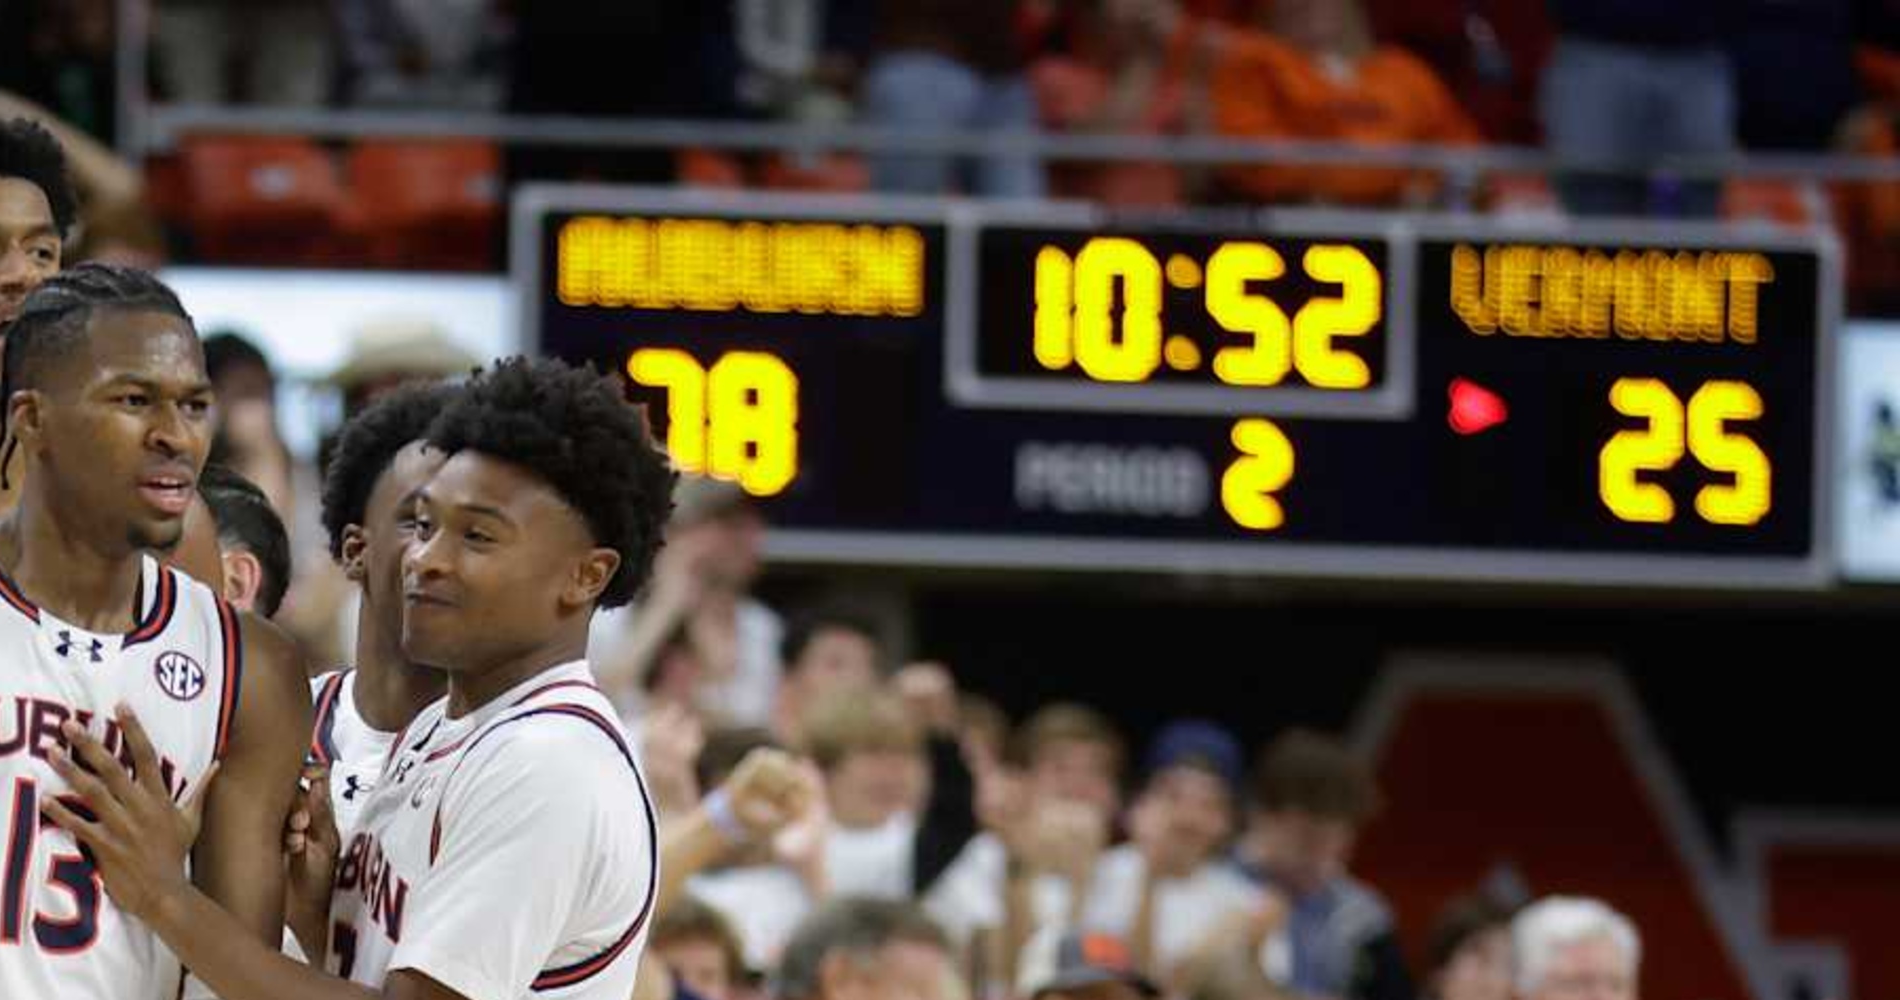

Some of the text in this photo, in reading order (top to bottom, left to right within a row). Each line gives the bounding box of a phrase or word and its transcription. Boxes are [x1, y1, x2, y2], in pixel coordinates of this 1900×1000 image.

[1034, 237, 1383, 389] 10:52
[1451, 245, 1774, 343] VERMONT
[627, 348, 799, 496] 78
[1014, 418, 1295, 530] PERIOD 2
[1600, 378, 1771, 524] 25
[158, 653, 204, 699] SEC
